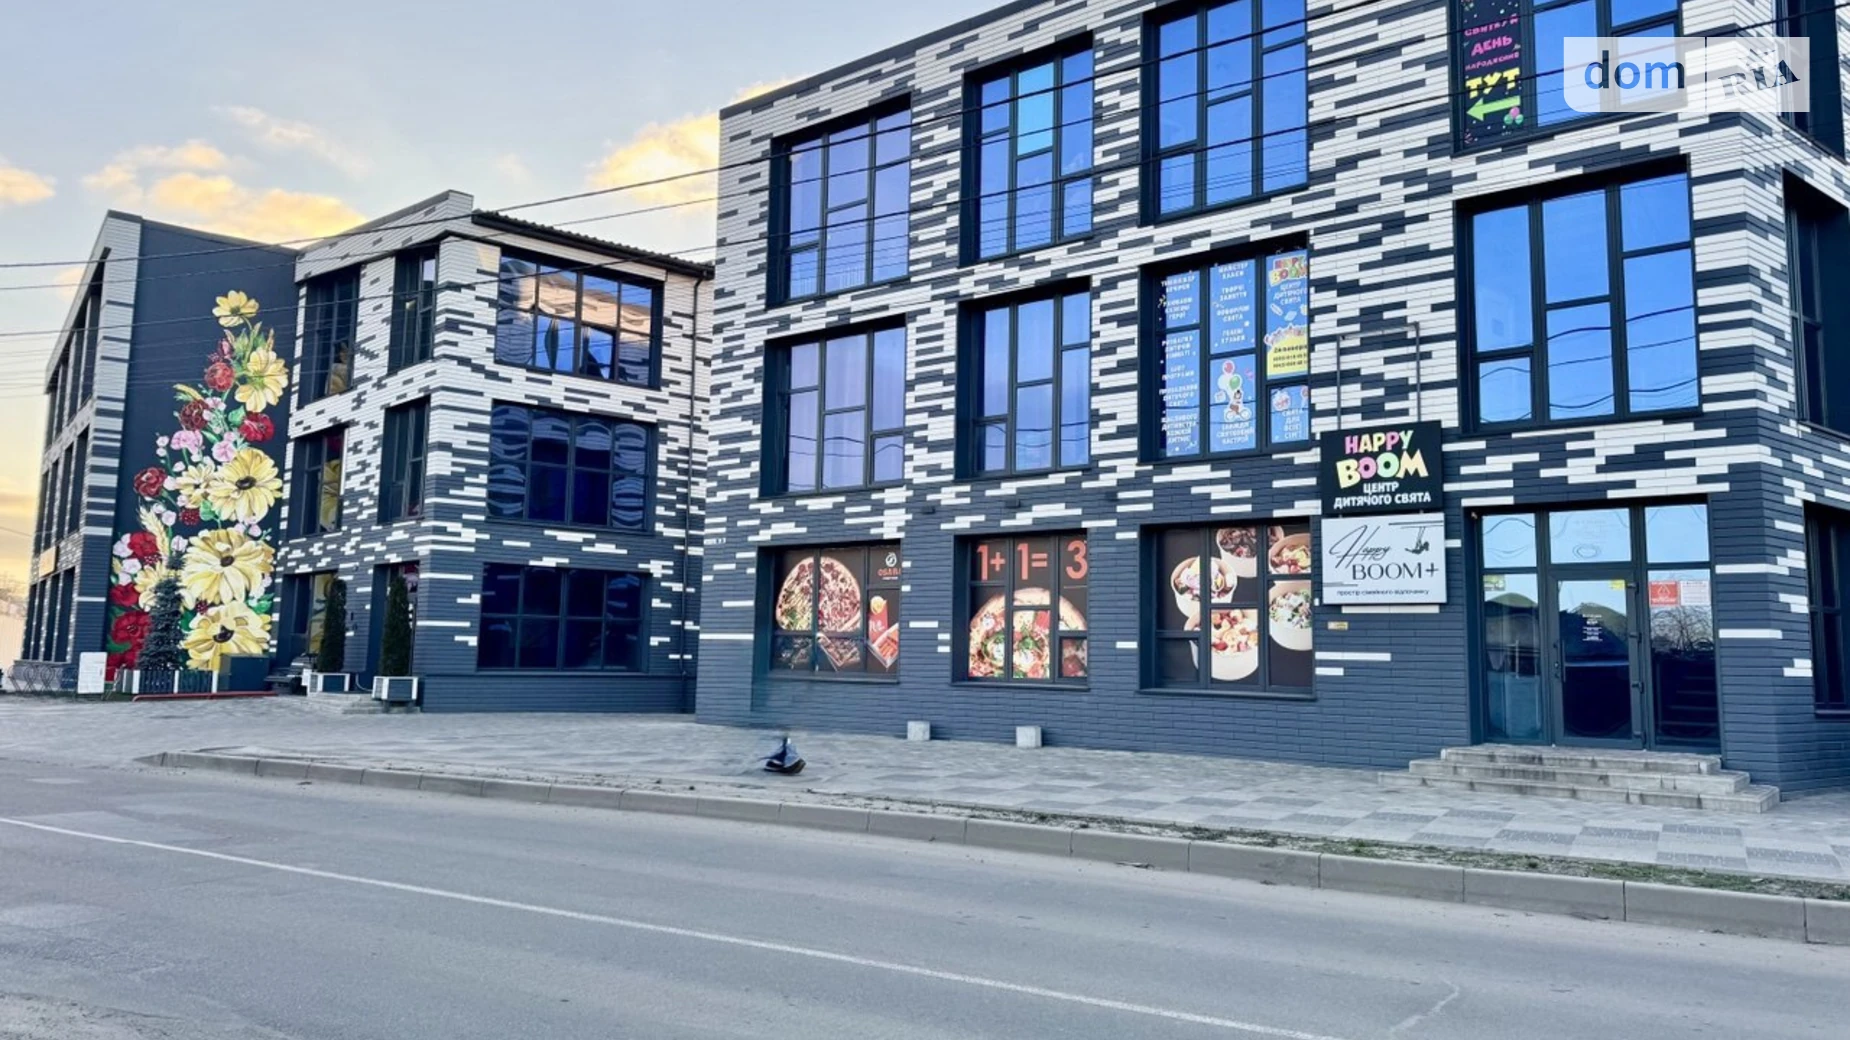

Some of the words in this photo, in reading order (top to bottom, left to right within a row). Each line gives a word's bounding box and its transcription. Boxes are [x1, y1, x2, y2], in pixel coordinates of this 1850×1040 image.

[1471, 36, 1512, 57] ДЕНЬ
[1465, 67, 1520, 99] ТУТ
[1345, 430, 1414, 455] HAPPY
[1336, 448, 1429, 489] BOOM
[1333, 494, 1392, 510] ДИТЯЧОГО
[1394, 491, 1432, 504] СВЯТА
[1363, 481, 1399, 495] ЦЕНТР
[1329, 524, 1391, 569] Happy
